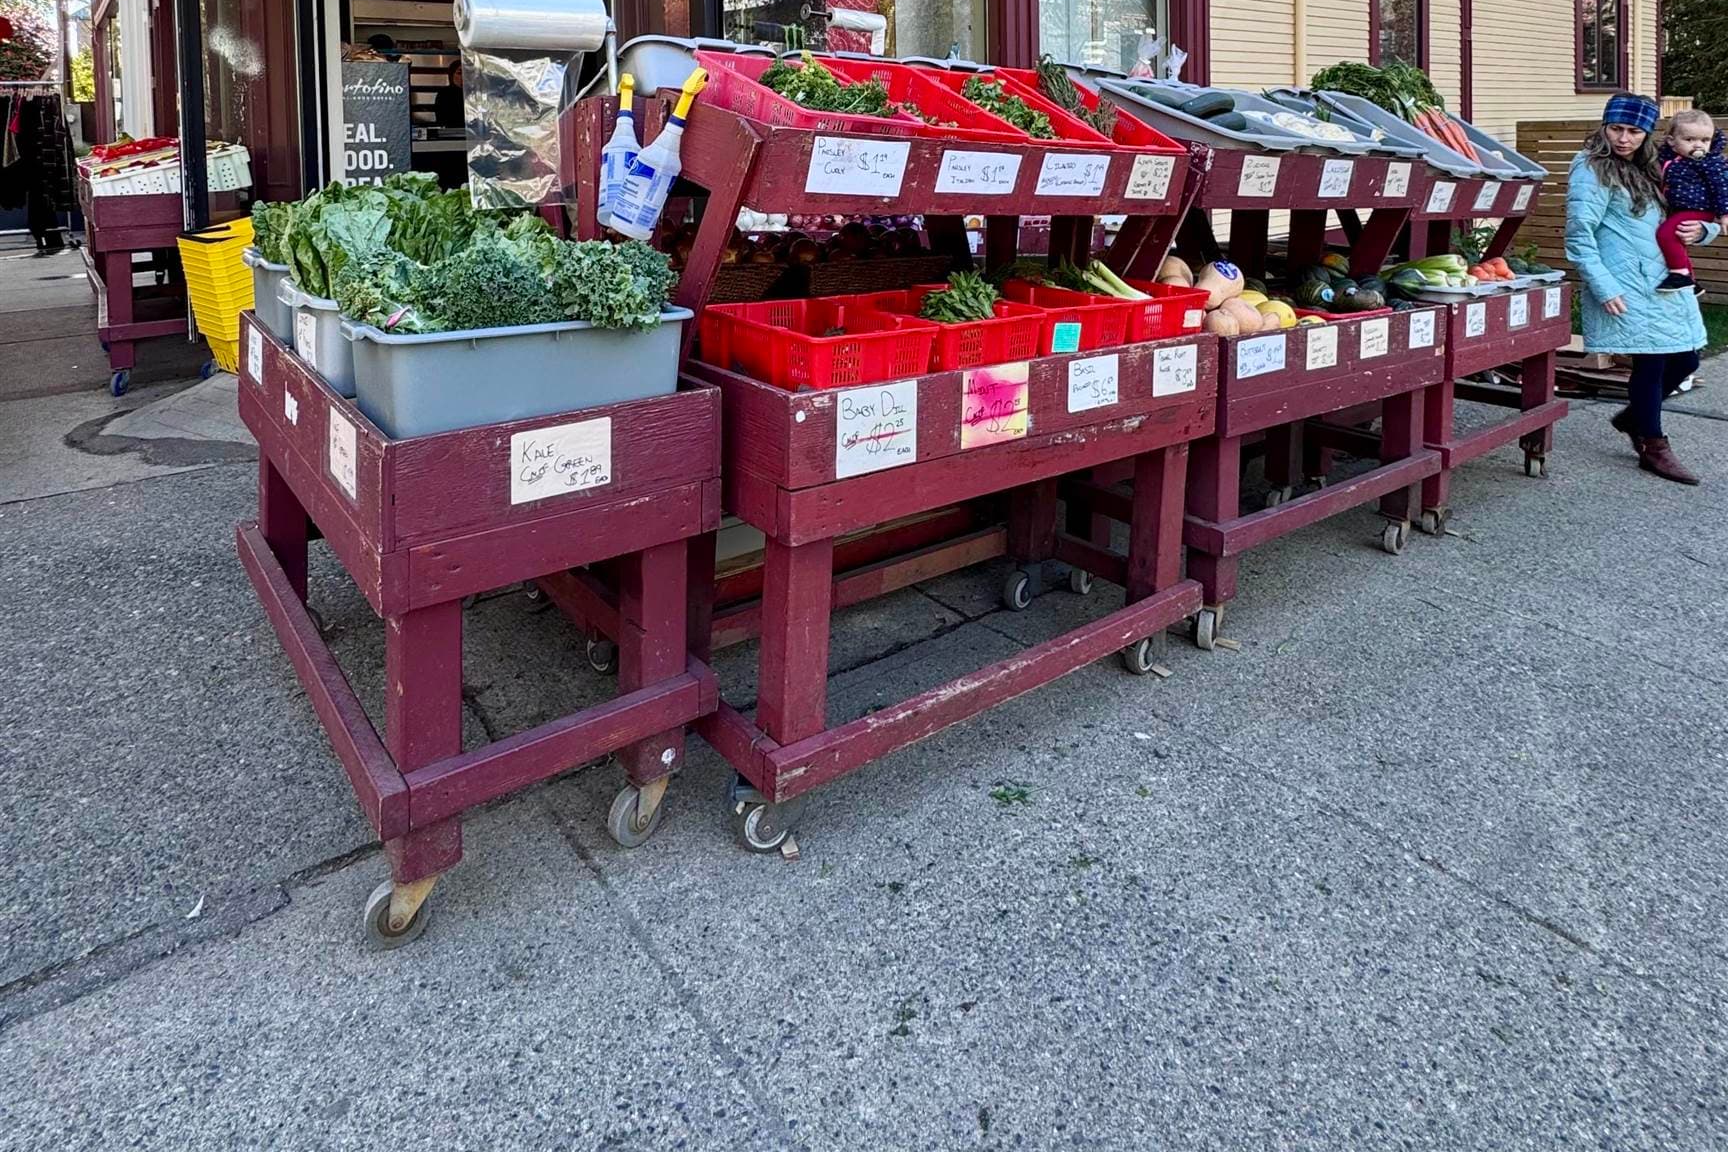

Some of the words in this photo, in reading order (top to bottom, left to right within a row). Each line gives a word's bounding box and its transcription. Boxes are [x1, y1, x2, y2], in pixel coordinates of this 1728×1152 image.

[343, 78, 403, 95] rtofino
[344, 122, 387, 143] EAL.
[345, 149, 394, 171] OOD.
[842, 397, 876, 421] BABY
[522, 440, 555, 464] KALE
[554, 454, 594, 474] GREEN
